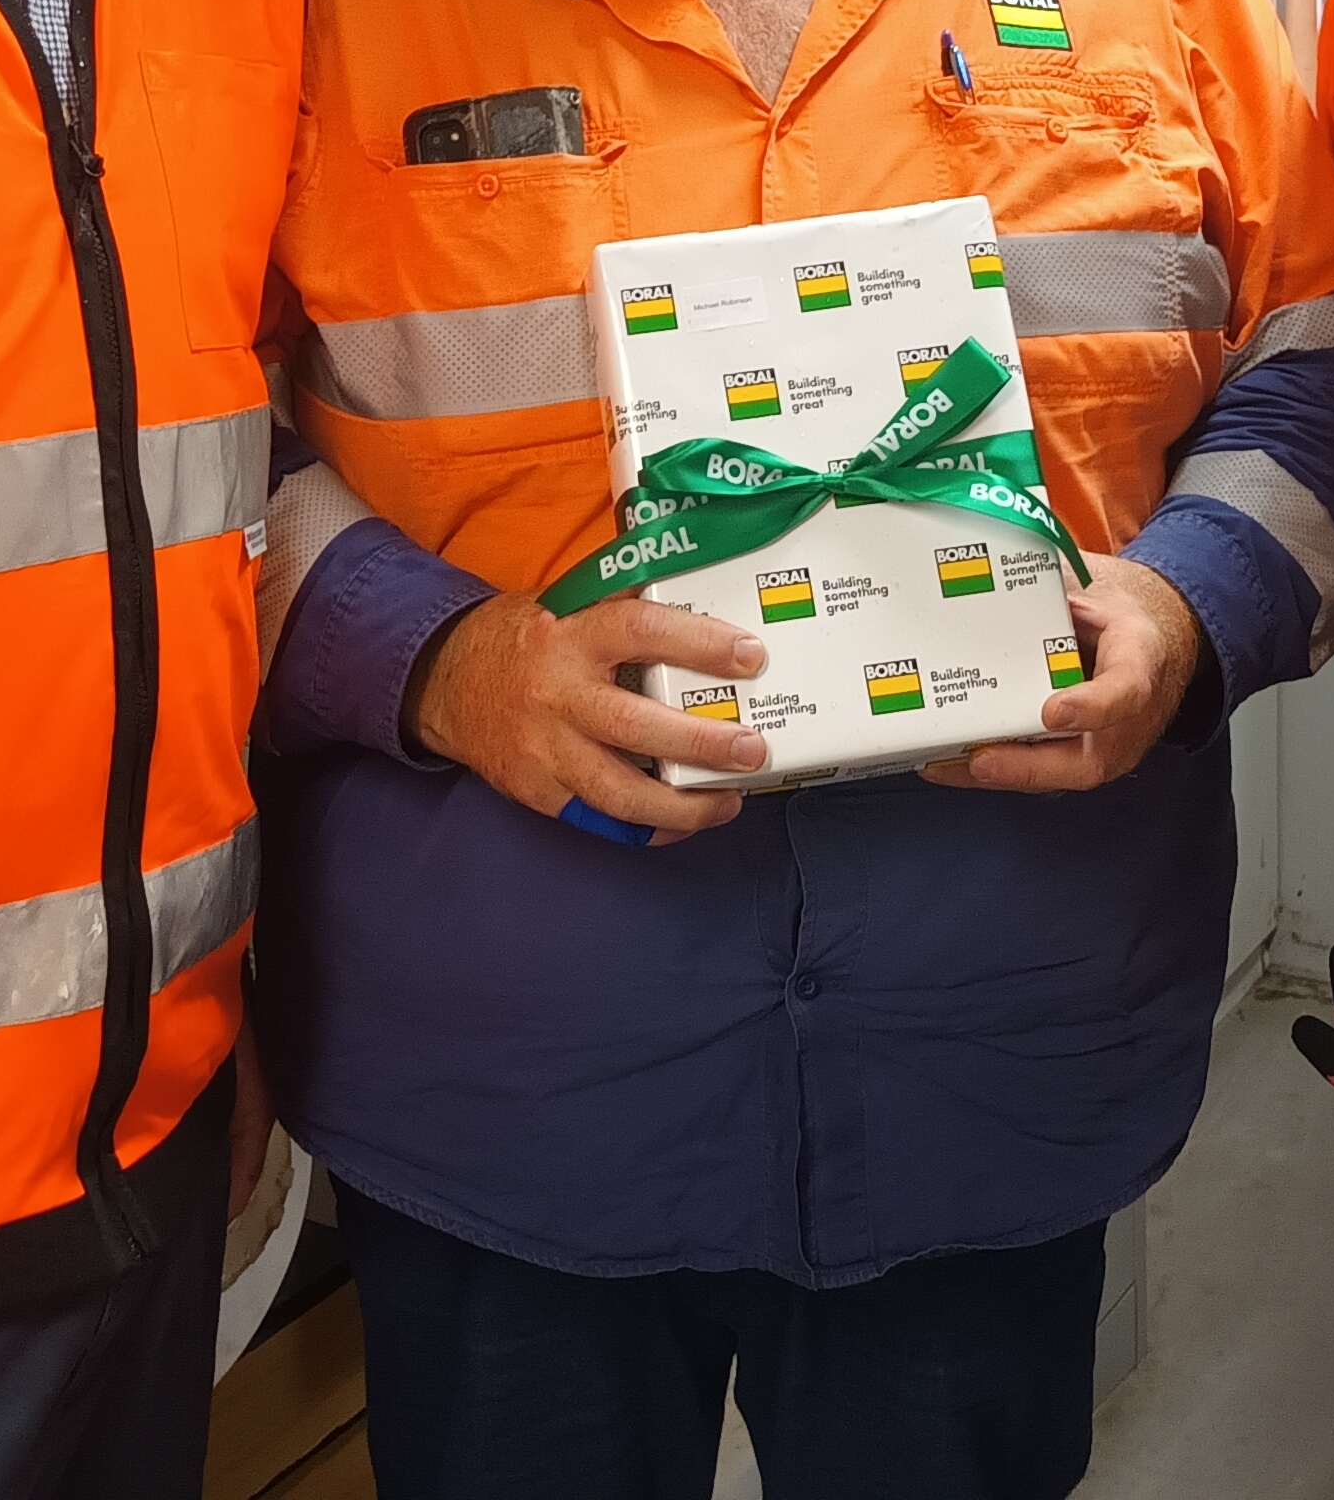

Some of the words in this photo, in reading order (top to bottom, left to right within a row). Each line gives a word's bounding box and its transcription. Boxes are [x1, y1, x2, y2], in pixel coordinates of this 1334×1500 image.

[795, 263, 844, 280] BORAL
[857, 269, 904, 282] Building
[860, 278, 921, 292] something
[622, 285, 672, 303] BORAL
[861, 291, 893, 305] great
[899, 346, 948, 364] BORAL
[725, 370, 775, 387] BORAL
[788, 376, 835, 390] Building
[790, 386, 852, 400] something
[792, 399, 823, 414] great
[862, 388, 954, 461] BORAL
[707, 453, 784, 487] BORA
[970, 483, 1060, 539] BORAL
[600, 527, 698, 580] BORAL
[936, 545, 987, 563] BORAL
[1001, 551, 1049, 565] Building
[758, 569, 809, 588] BORAL
[823, 577, 871, 590] Building
[1005, 575, 1038, 591] great
[825, 585, 889, 602] something
[827, 601, 859, 616] great
[1045, 637, 1078, 653] BOR
[865, 660, 917, 679] BORAL
[931, 668, 980, 682] Building
[933, 676, 997, 693] something
[683, 687, 736, 707] BORAL
[749, 694, 799, 709] Building
[935, 693, 968, 708] great
[752, 702, 817, 720] something
[753, 718, 786, 732] great
